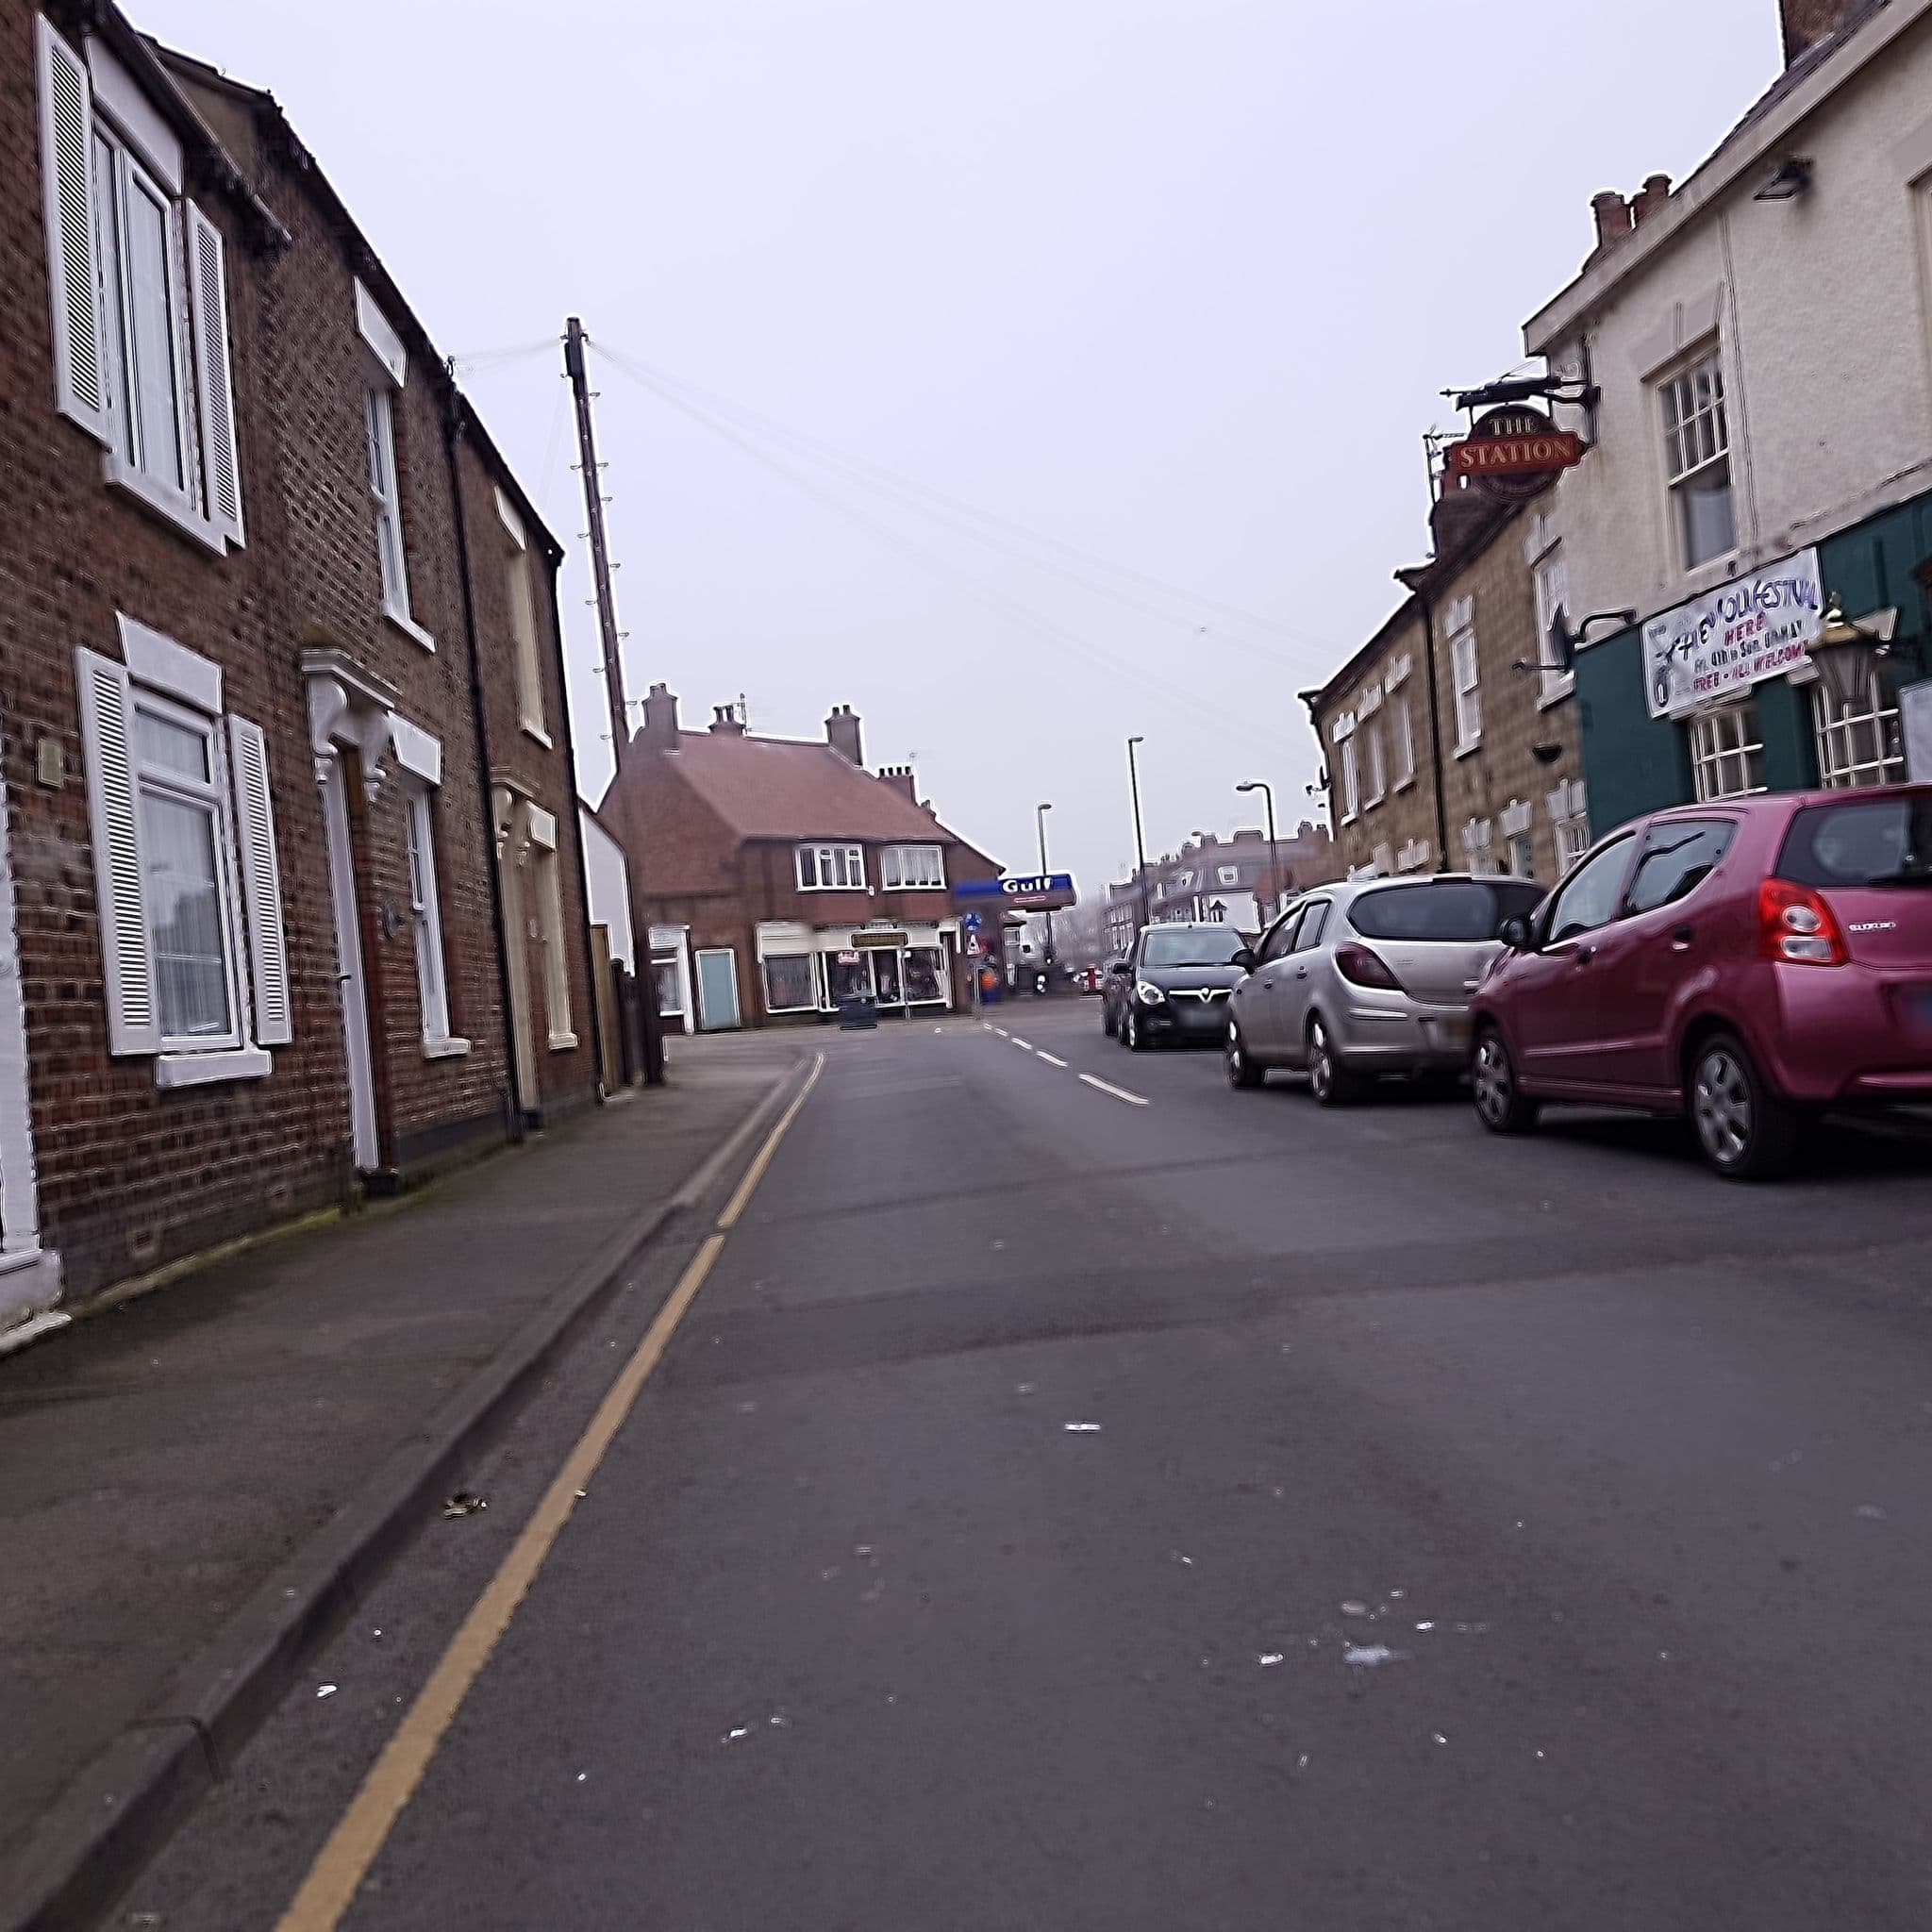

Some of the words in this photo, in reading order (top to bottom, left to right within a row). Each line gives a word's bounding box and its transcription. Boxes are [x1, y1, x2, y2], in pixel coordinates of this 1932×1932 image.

[1490, 416, 1538, 435] THE
[1460, 440, 1571, 467] STATION
[1724, 612, 1767, 647] HERE
[1692, 671, 1720, 694] FREE
[1003, 877, 1051, 892] Gulf
